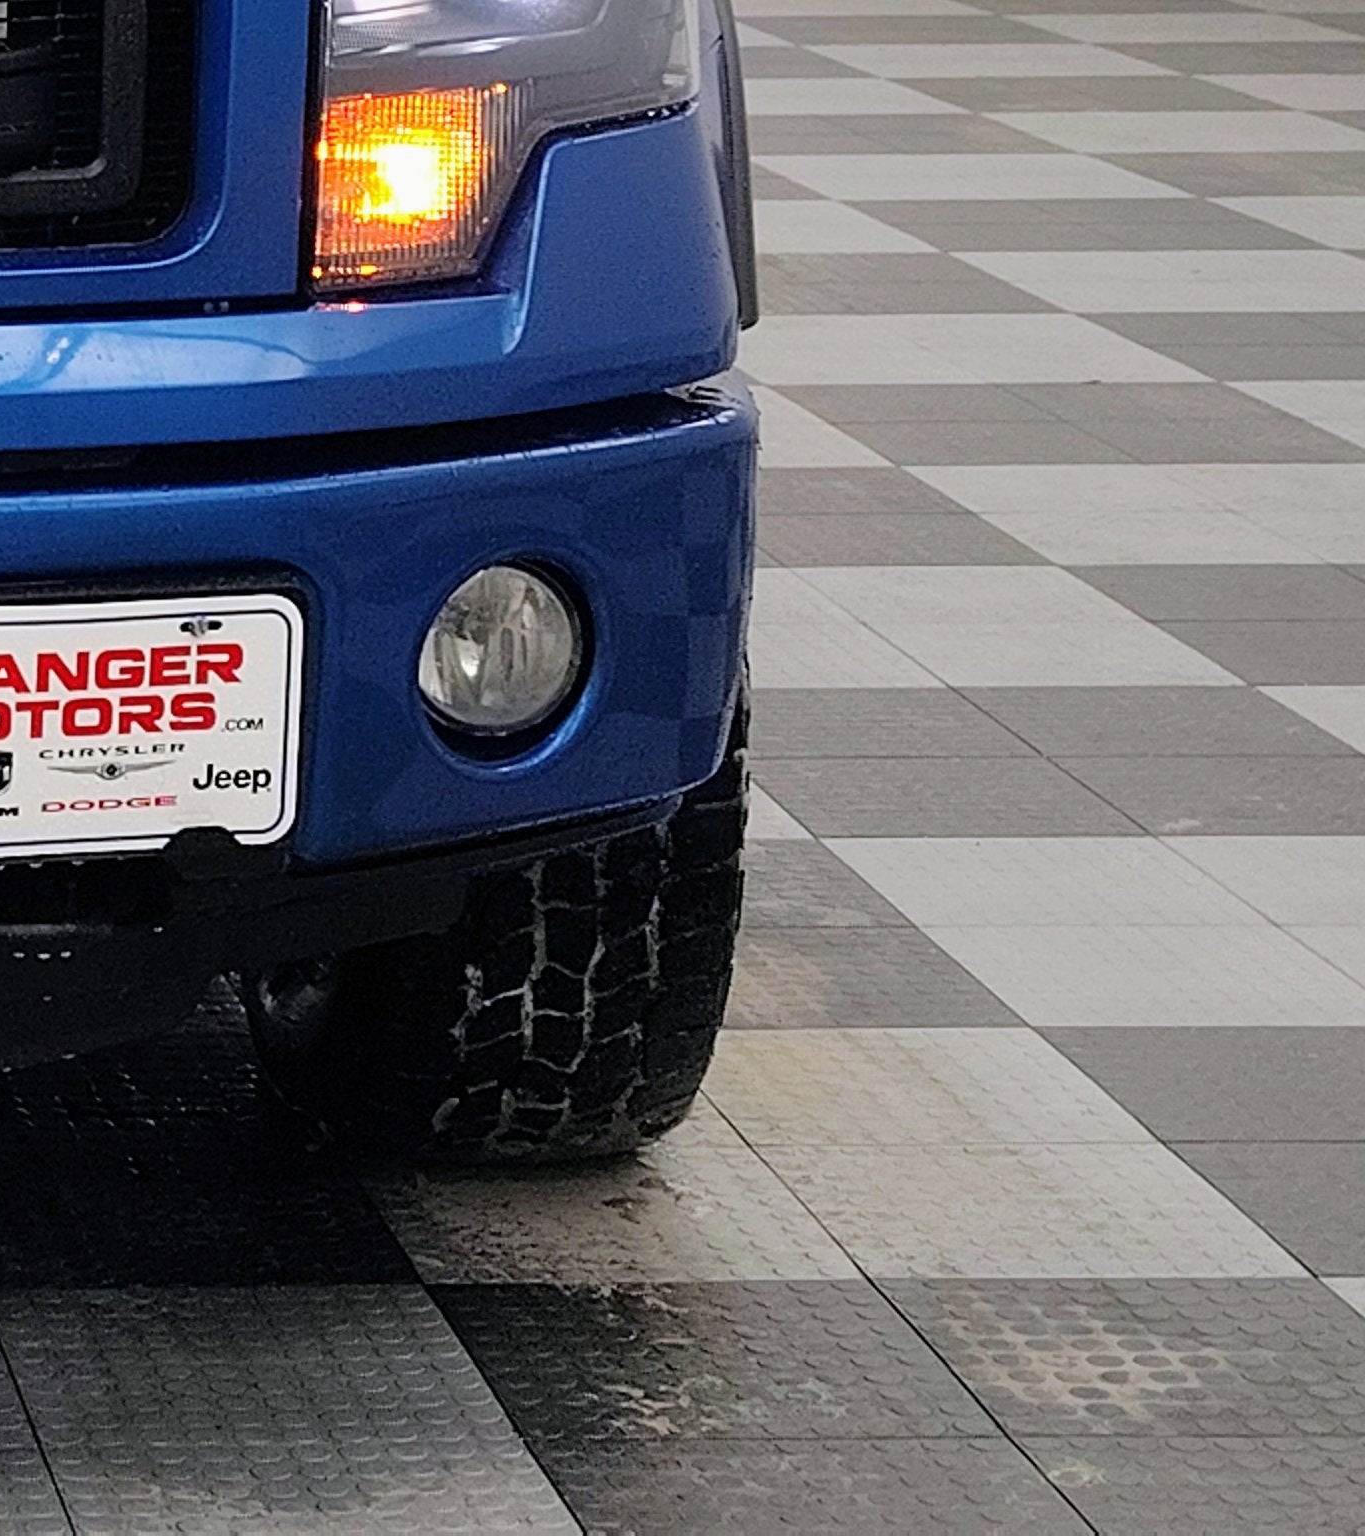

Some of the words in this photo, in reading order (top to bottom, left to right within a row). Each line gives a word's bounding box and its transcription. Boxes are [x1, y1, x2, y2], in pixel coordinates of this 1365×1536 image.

[38, 743, 186, 760] CHRYSLER
[192, 763, 271, 794] Jeep
[41, 795, 178, 813] DODGE
